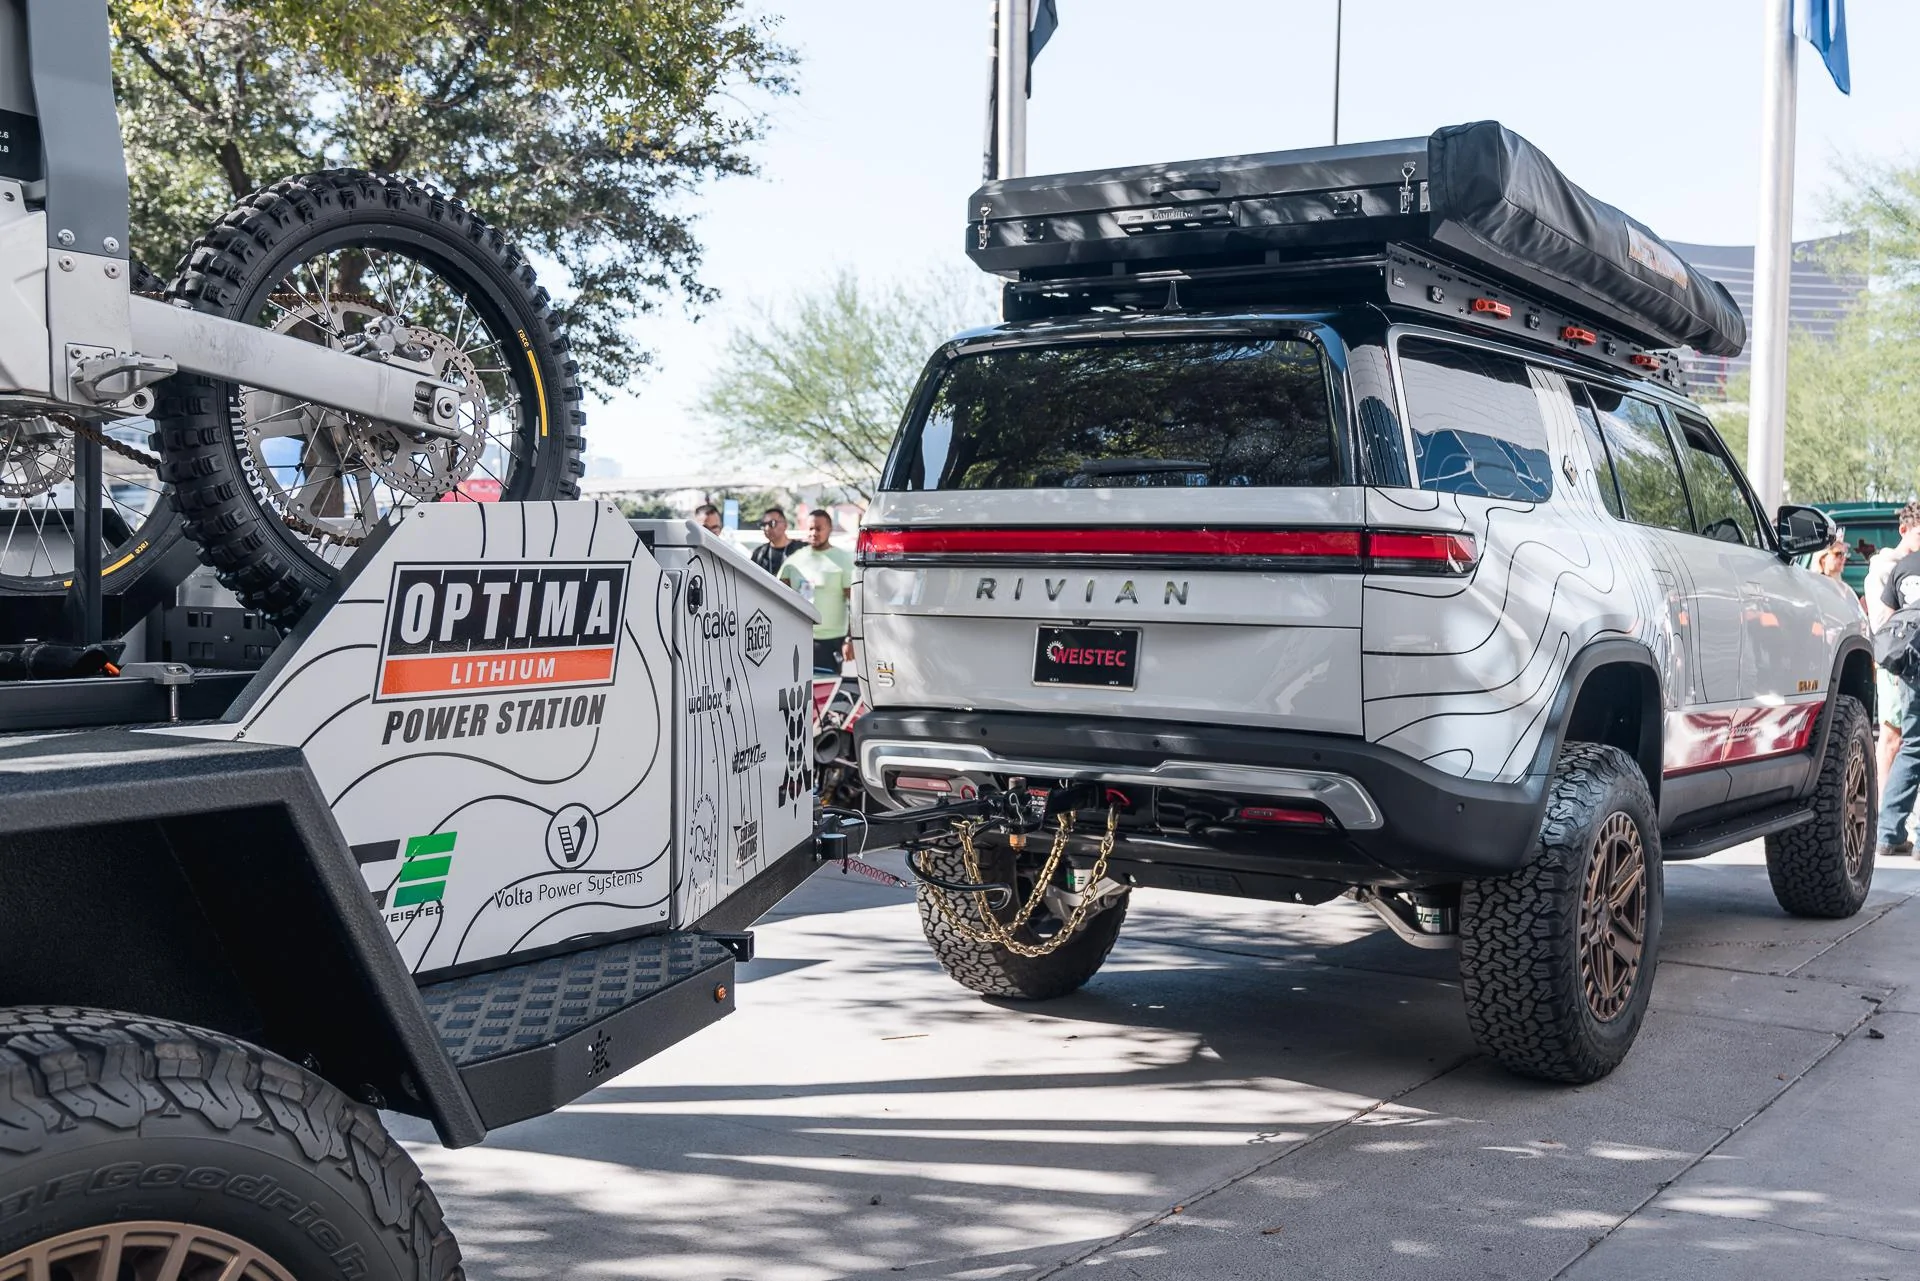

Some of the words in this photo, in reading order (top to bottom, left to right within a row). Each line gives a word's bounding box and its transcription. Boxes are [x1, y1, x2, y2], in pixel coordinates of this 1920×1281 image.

[516, 328, 530, 348] race
[976, 577, 1190, 606] RIVIAN
[399, 579, 612, 645] OPTIMA
[702, 604, 737, 640] cake
[450, 657, 557, 685] LITHIUM
[1053, 646, 1127, 668] WEISTEC
[688, 685, 723, 715] wallbox
[381, 703, 490, 745] POWER
[496, 693, 608, 735] STATION
[492, 886, 534, 910] Volta
[538, 882, 583, 901] Power
[588, 869, 644, 895] Systems
